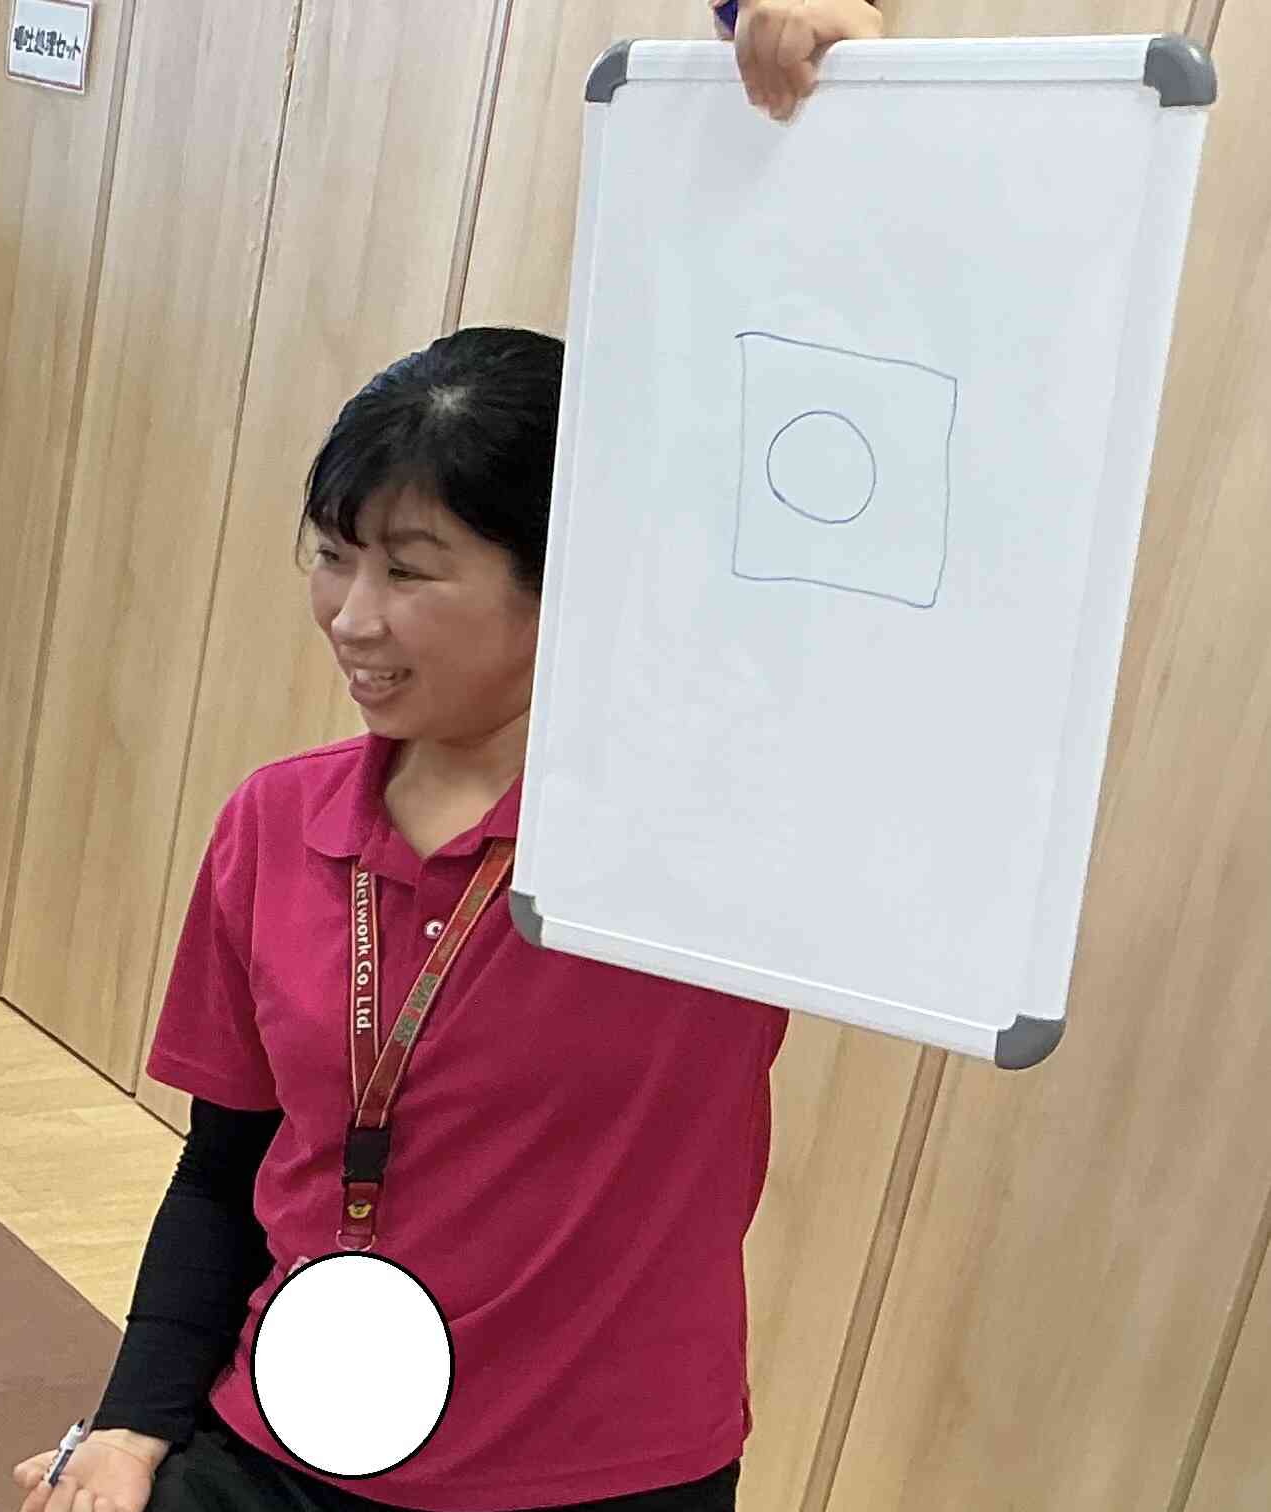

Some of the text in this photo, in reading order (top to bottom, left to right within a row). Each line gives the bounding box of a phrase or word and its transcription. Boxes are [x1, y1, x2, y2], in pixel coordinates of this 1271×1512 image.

[356, 872, 373, 1035] Network Co. Ltd.
